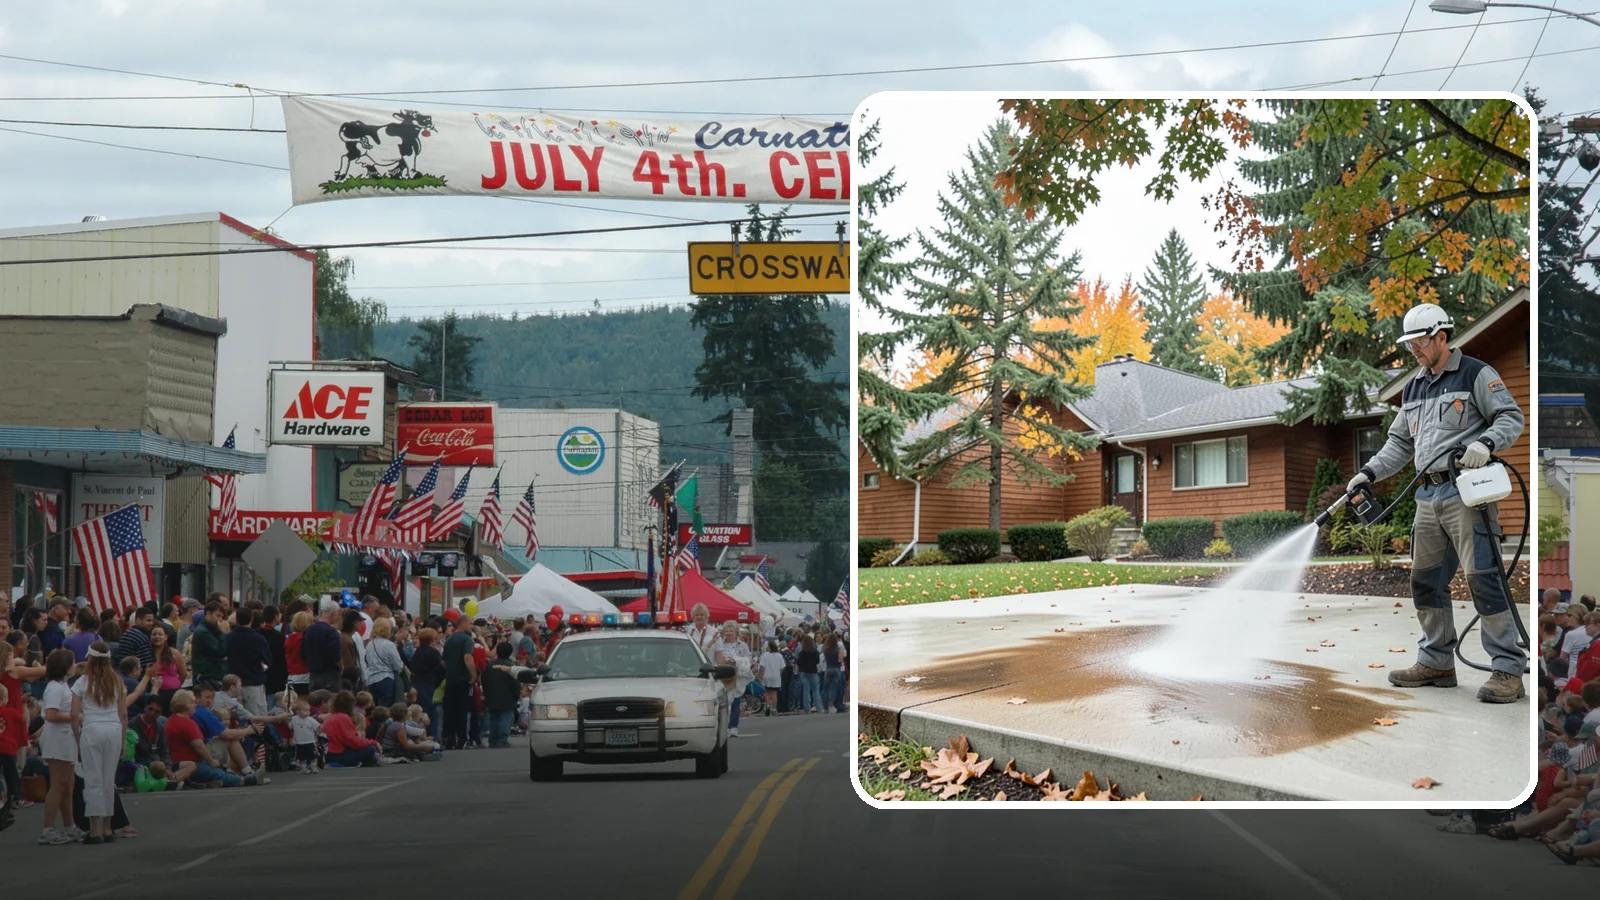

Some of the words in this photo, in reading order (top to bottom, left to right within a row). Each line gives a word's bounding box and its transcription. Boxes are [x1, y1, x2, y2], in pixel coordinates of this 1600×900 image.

[481, 141, 604, 192] JULY
[632, 150, 746, 197] 4th.
[697, 254, 849, 280] CROSSWA
[282, 380, 373, 419] ACE
[406, 409, 453, 422] CEDAR
[461, 409, 485, 422] LOG
[283, 421, 370, 436] Hardware
[416, 427, 477, 446] Coca-Cola
[83, 484, 93, 494] St.
[95, 485, 124, 494] Vincent
[126, 486, 136, 494] de
[138, 486, 155, 495] Paul
[688, 526, 741, 535] CRNATION
[699, 535, 730, 543] GLASS
